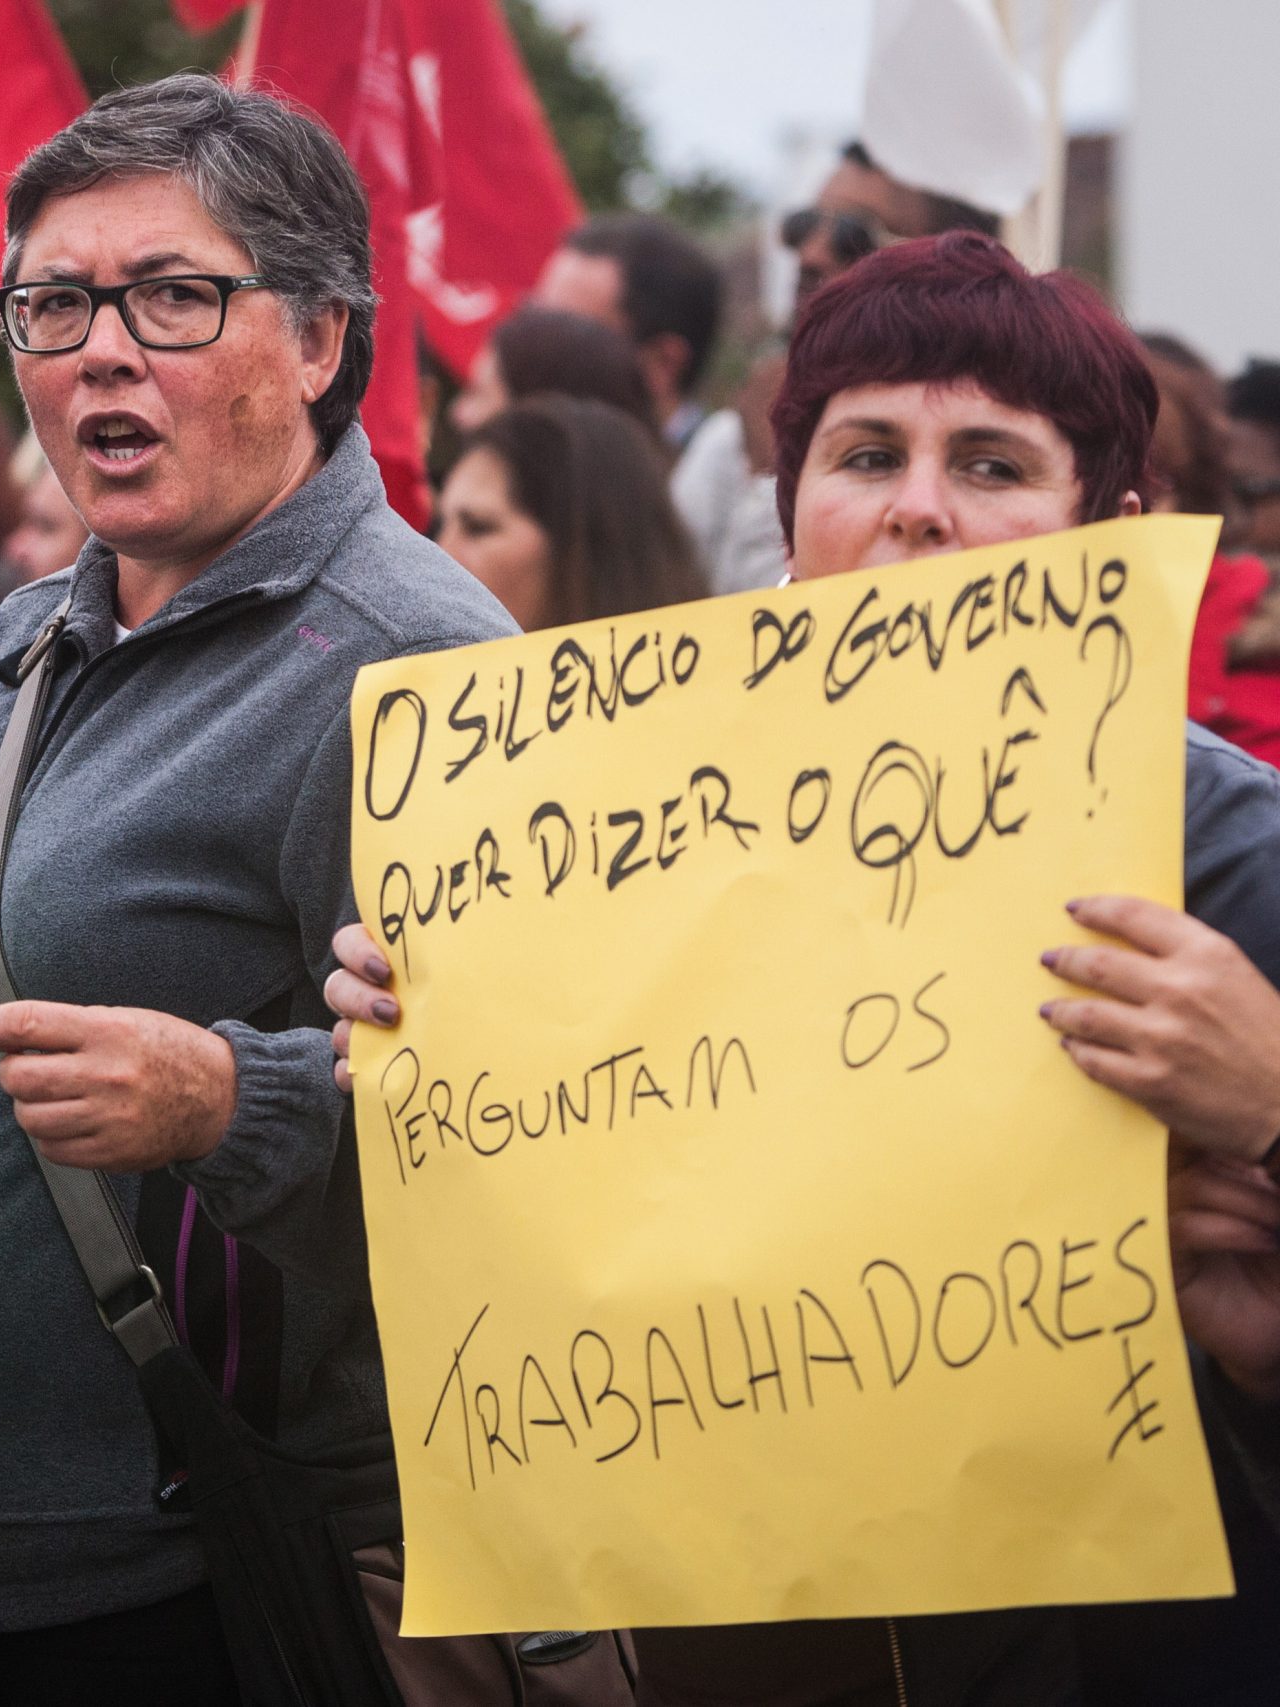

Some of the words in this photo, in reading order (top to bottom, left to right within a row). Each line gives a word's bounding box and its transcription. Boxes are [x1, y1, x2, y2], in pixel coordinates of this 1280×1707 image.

[365, 688, 427, 821] O
[743, 608, 816, 690] DO
[825, 550, 1127, 703] GOVERNO
[380, 828, 511, 983] QUER
[788, 767, 830, 844] O
[381, 1036, 756, 1185] PERGUNTAM
[841, 972, 950, 1072] OS
[424, 1218, 1157, 1490] TRABALHADORES
